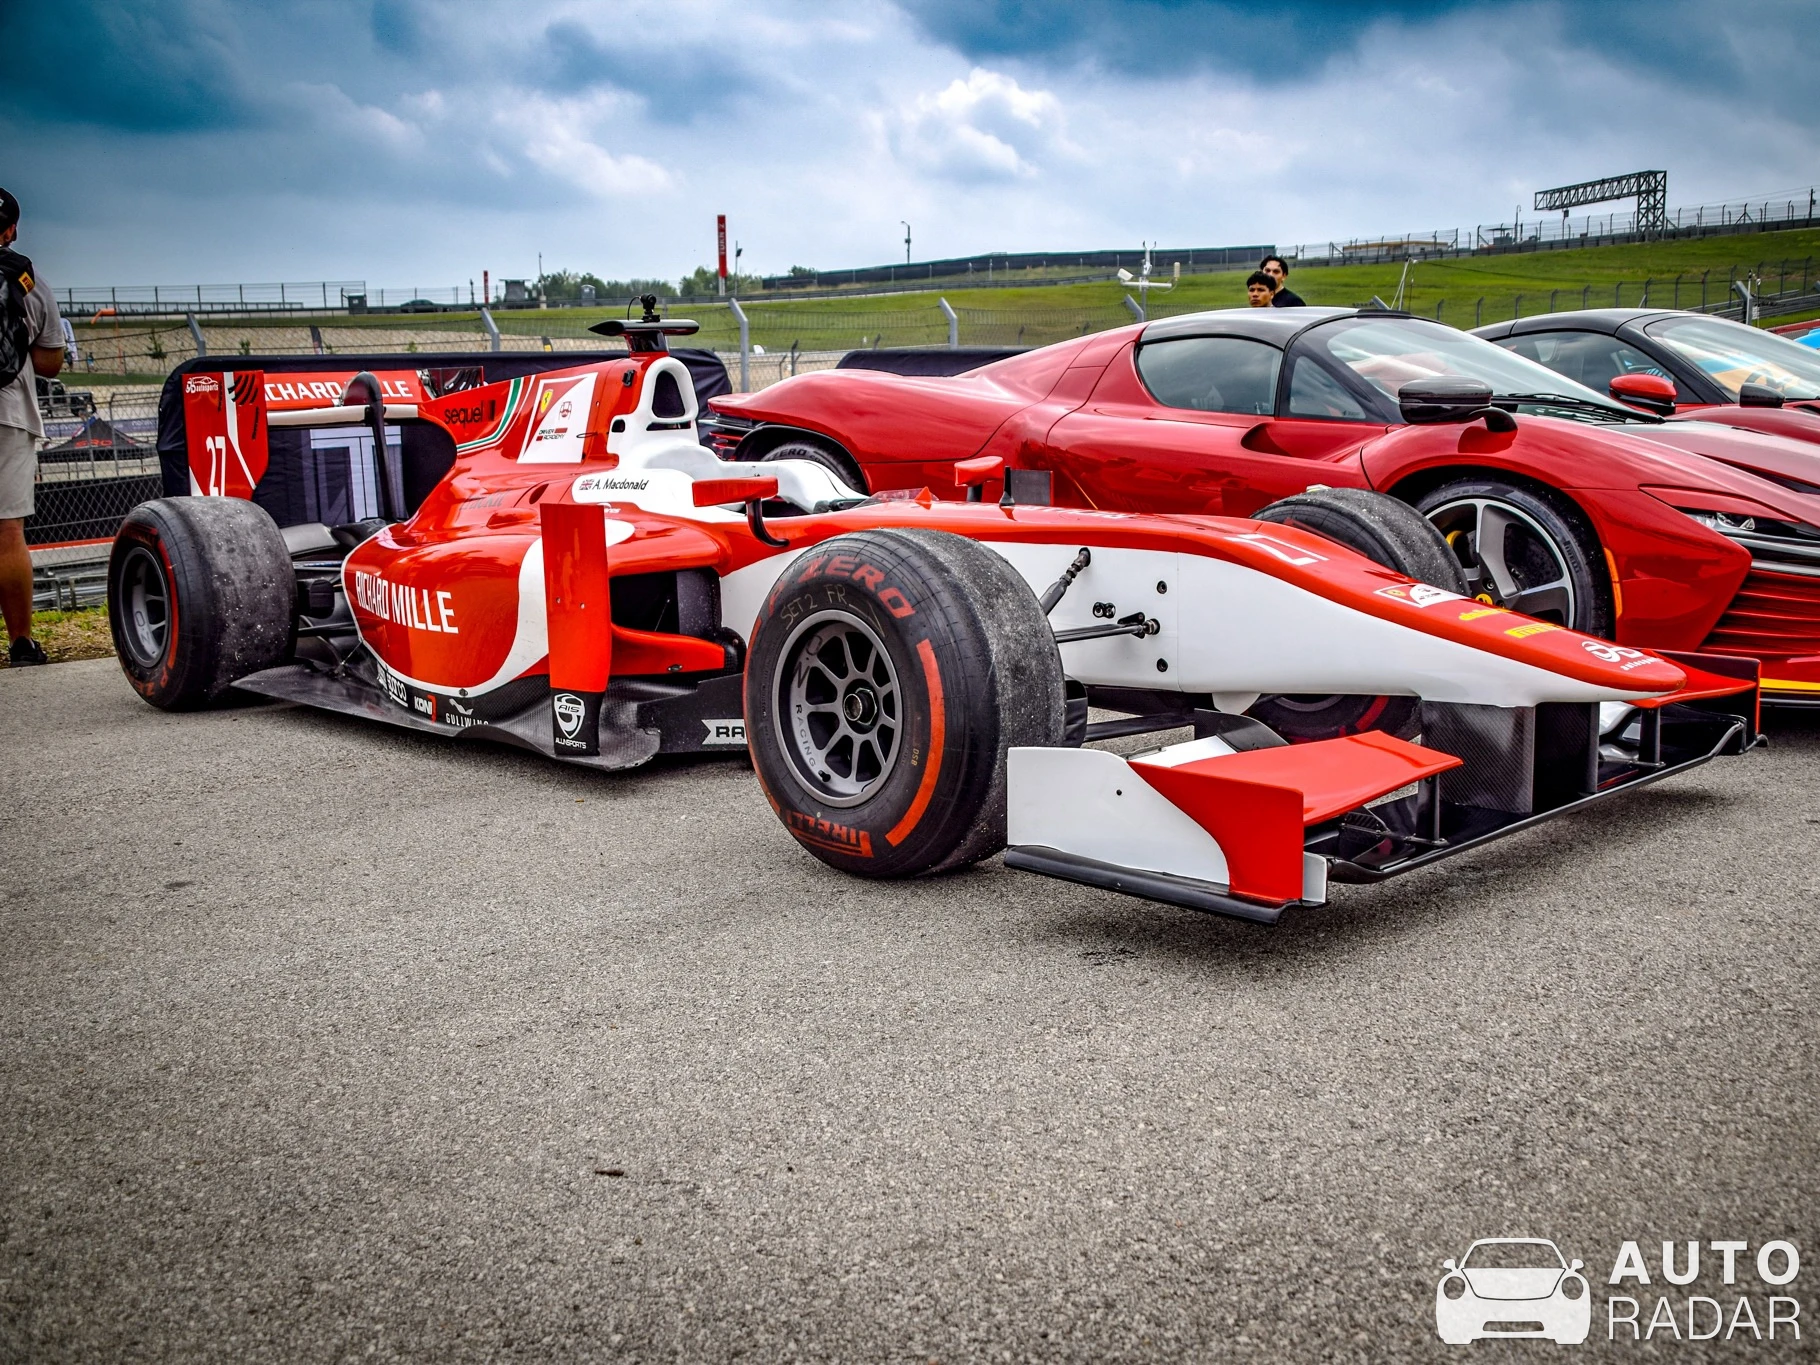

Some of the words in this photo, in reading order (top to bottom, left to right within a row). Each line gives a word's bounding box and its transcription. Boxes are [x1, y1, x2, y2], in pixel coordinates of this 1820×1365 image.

[264, 381, 343, 401] CHARD
[444, 400, 483, 428] sequel
[206, 436, 226, 496] 27
[603, 478, 649, 491] Macdonald
[356, 571, 390, 620] RICHARD
[392, 582, 459, 634] MILLE
[798, 555, 916, 619] ZERO
[558, 704, 580, 713] AIS
[796, 704, 816, 767] RACING
